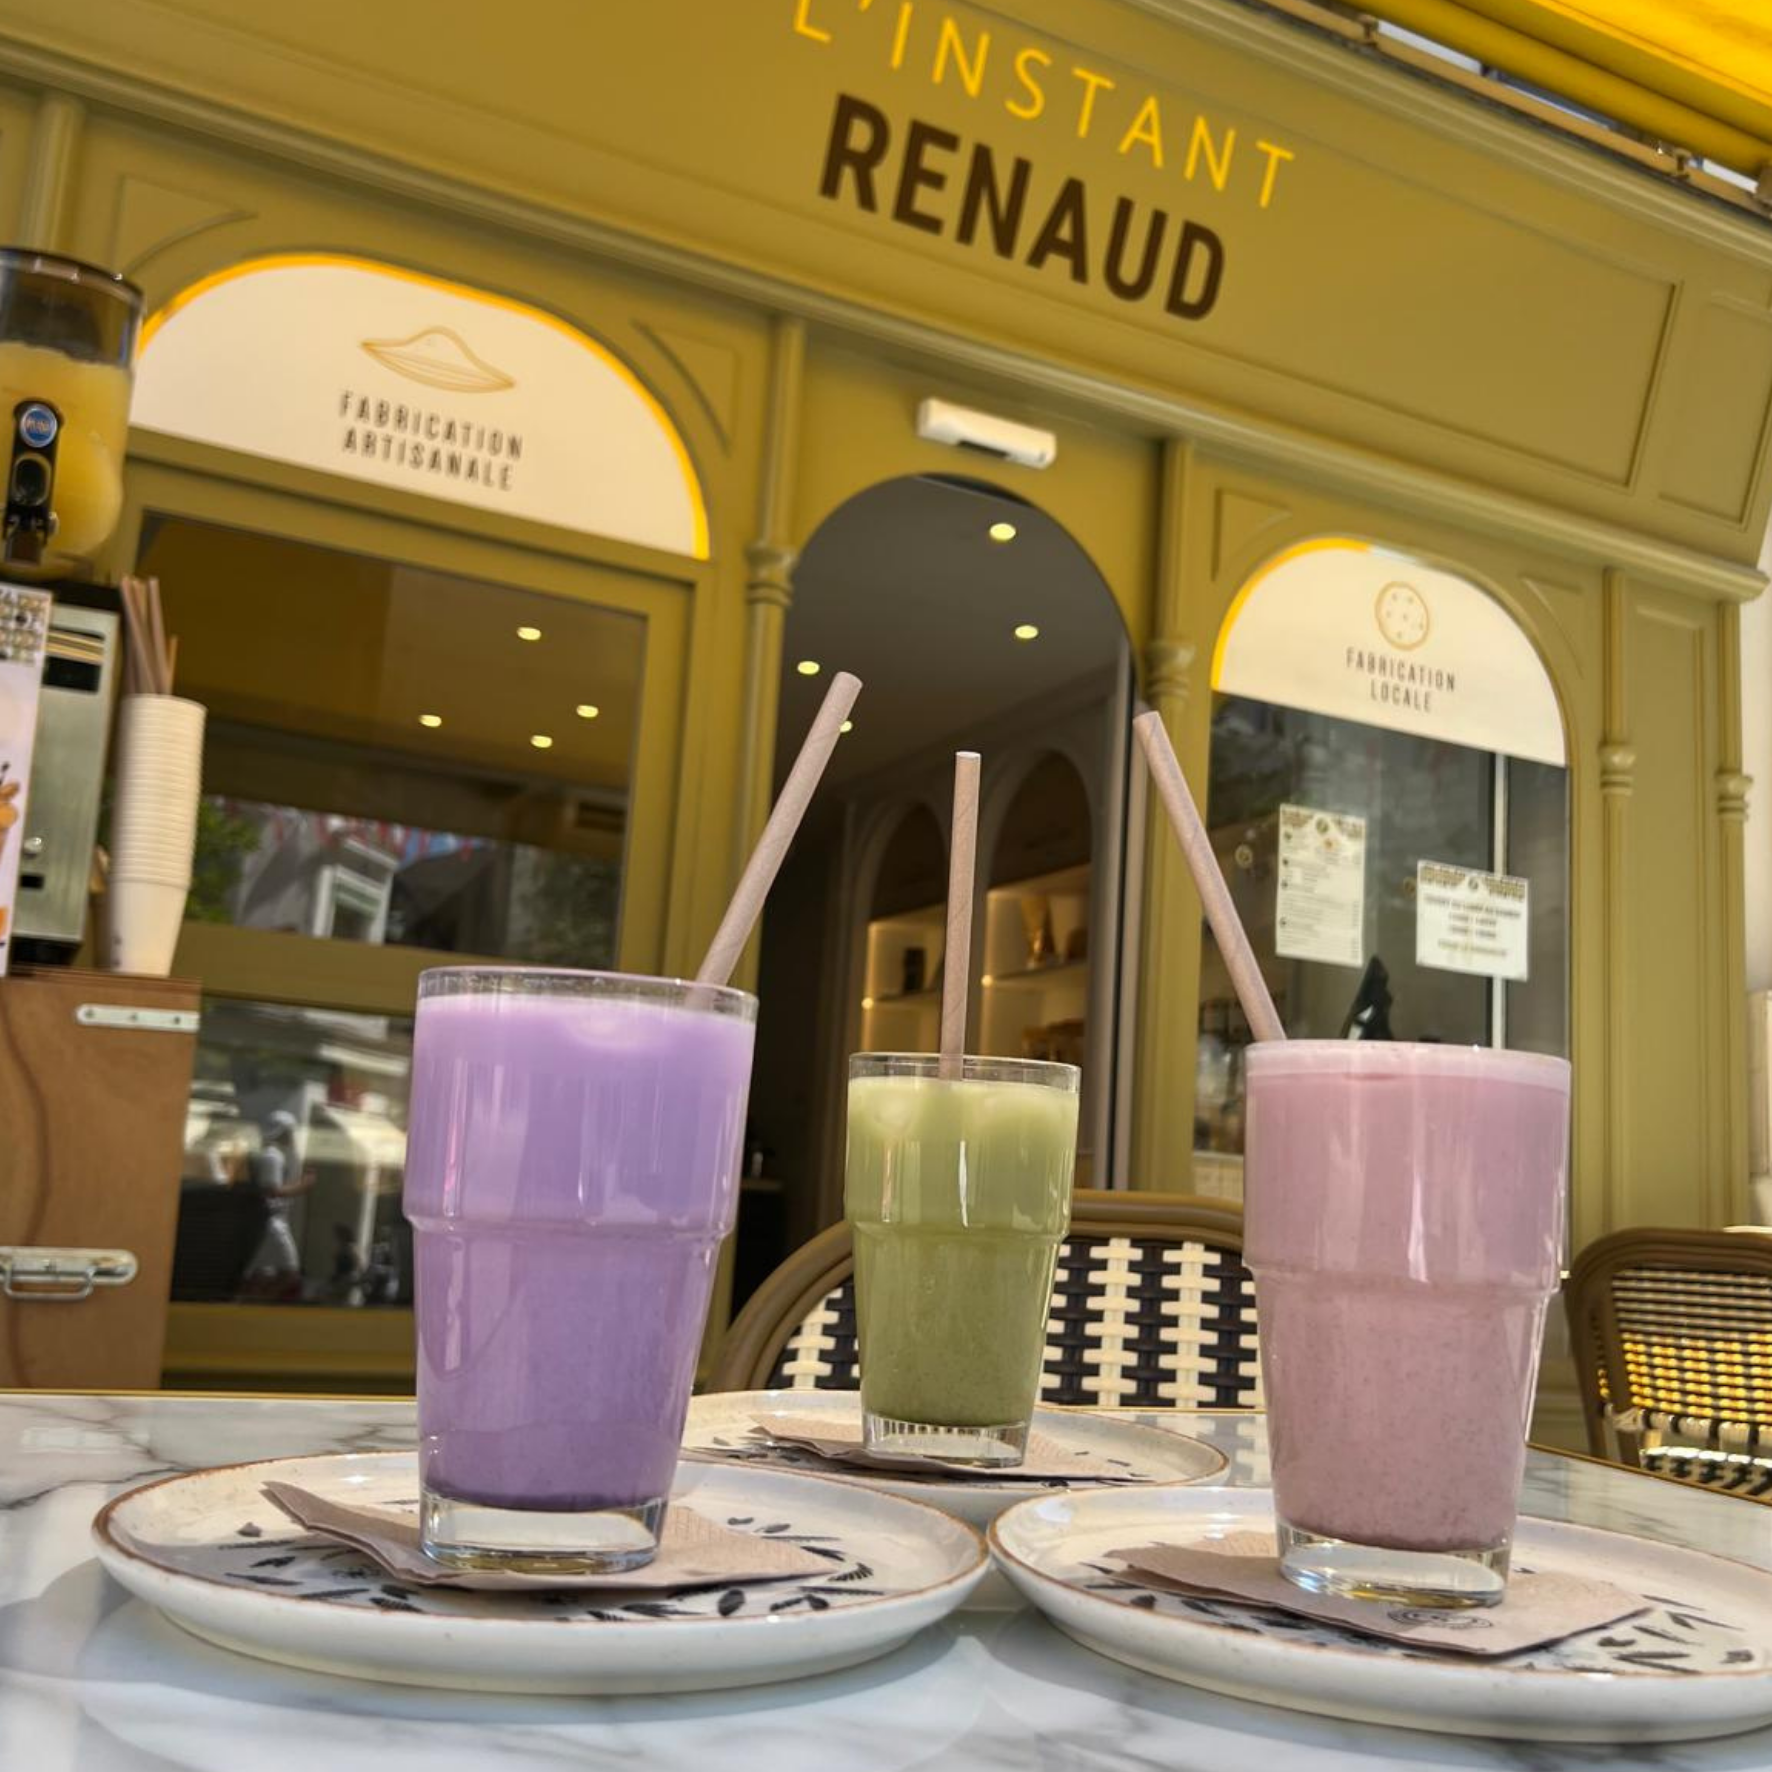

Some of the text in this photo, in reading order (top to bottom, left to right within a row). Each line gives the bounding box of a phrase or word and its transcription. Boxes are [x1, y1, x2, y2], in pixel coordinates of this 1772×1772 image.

[794, 0, 1295, 209] L'INSTANT
[819, 93, 1226, 322] RENAUD
[339, 391, 522, 459] FABRICATION
[343, 429, 512, 491] ARTISANALE
[1346, 648, 1455, 691] FABRICATION
[1371, 681, 1431, 712] LOCALE
